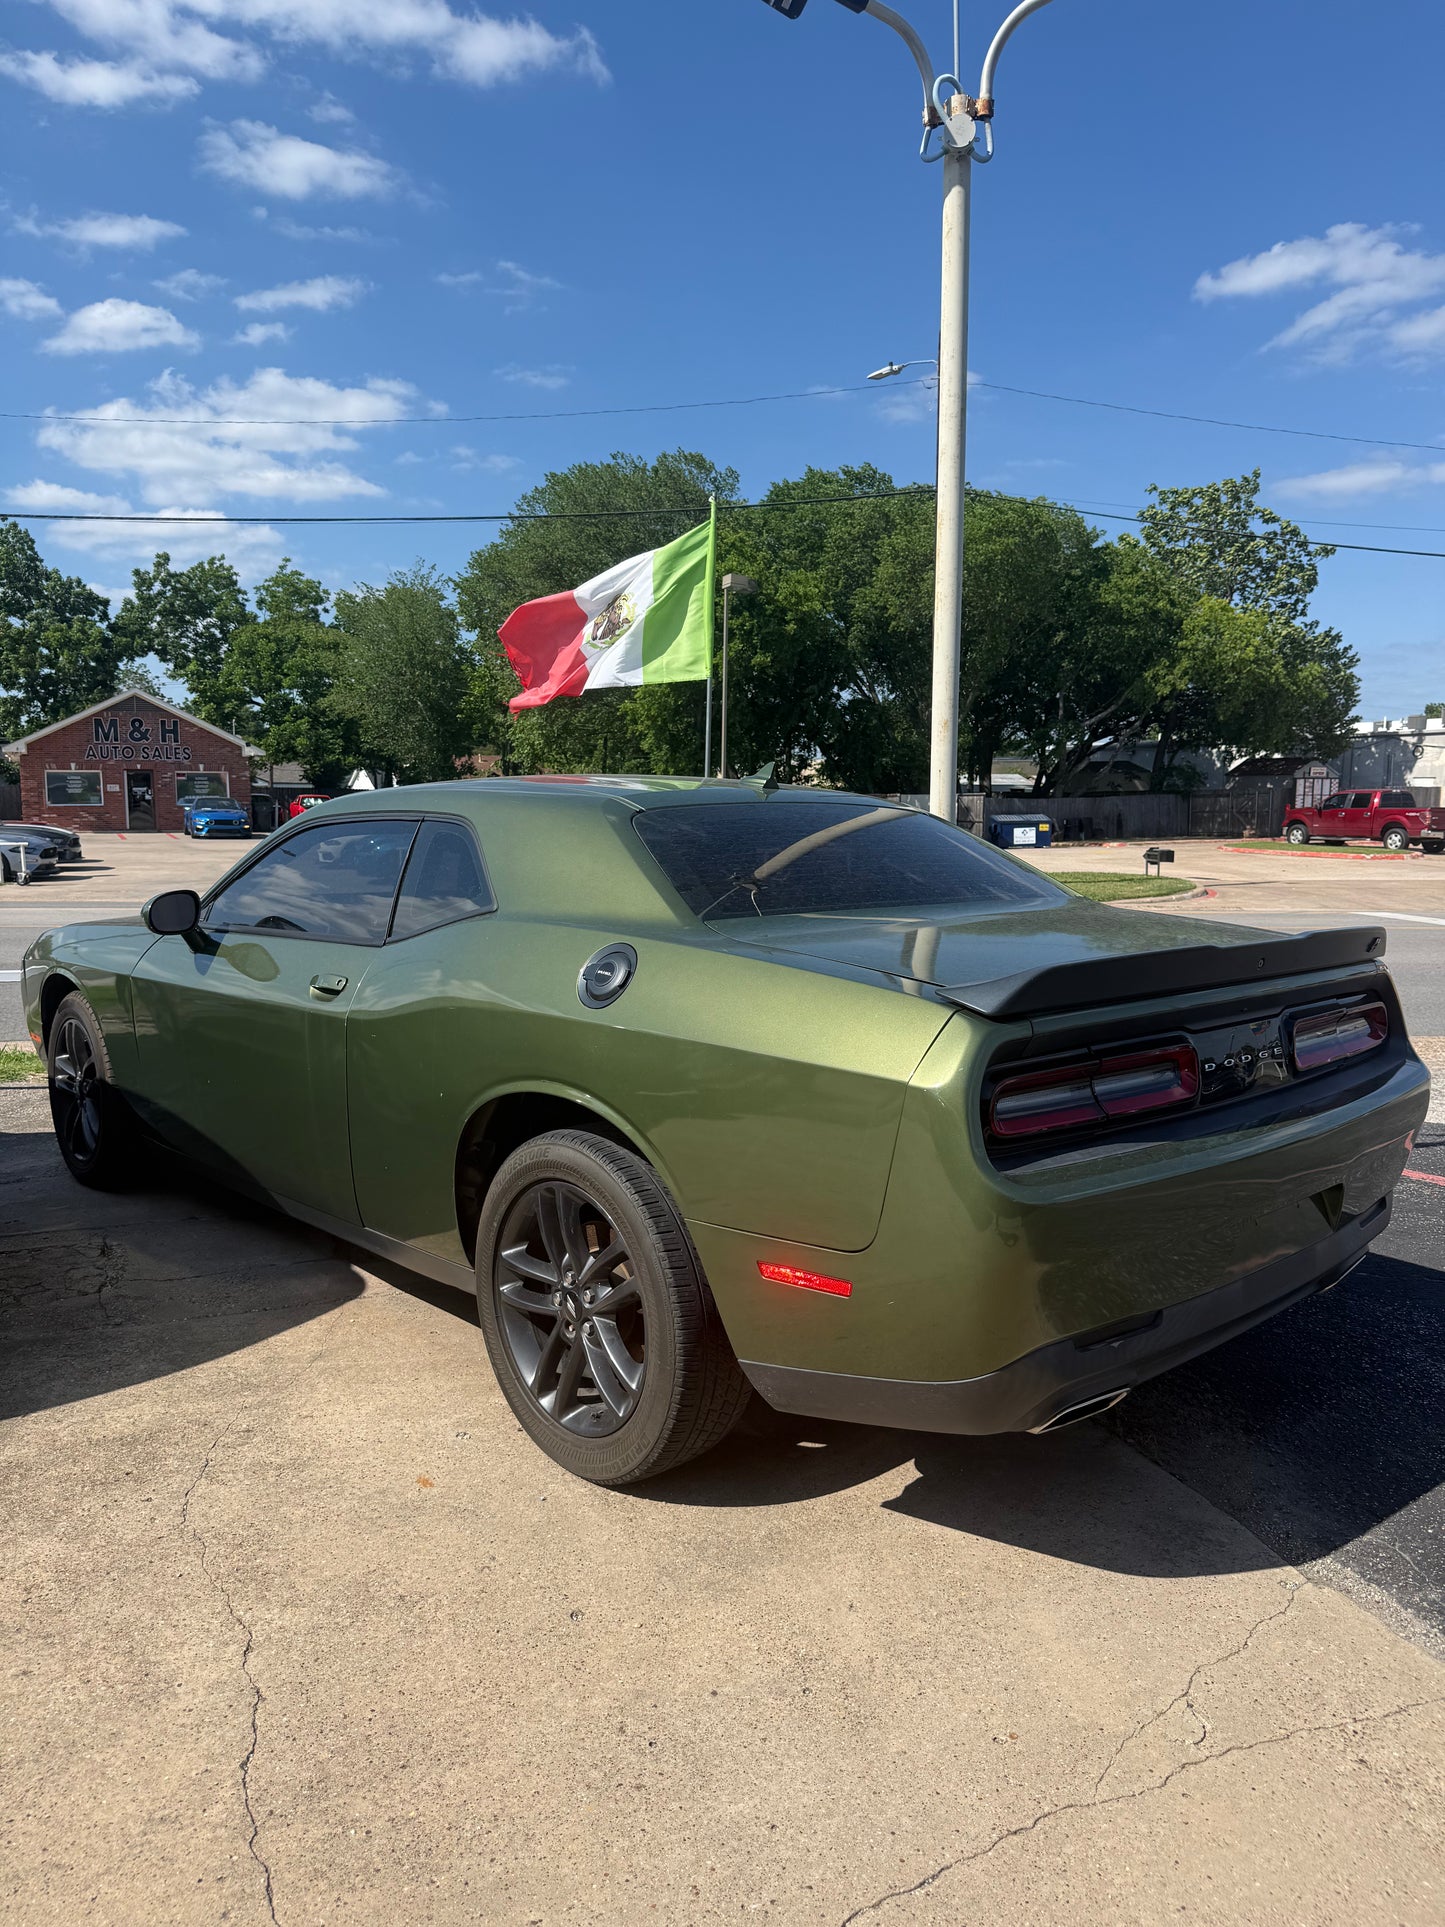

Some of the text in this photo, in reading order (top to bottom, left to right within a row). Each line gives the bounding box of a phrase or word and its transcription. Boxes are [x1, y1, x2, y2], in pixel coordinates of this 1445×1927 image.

[93, 717, 180, 744] M & H
[85, 745, 193, 762] AUTO SALES
[1204, 1046, 1282, 1071] DODGE
